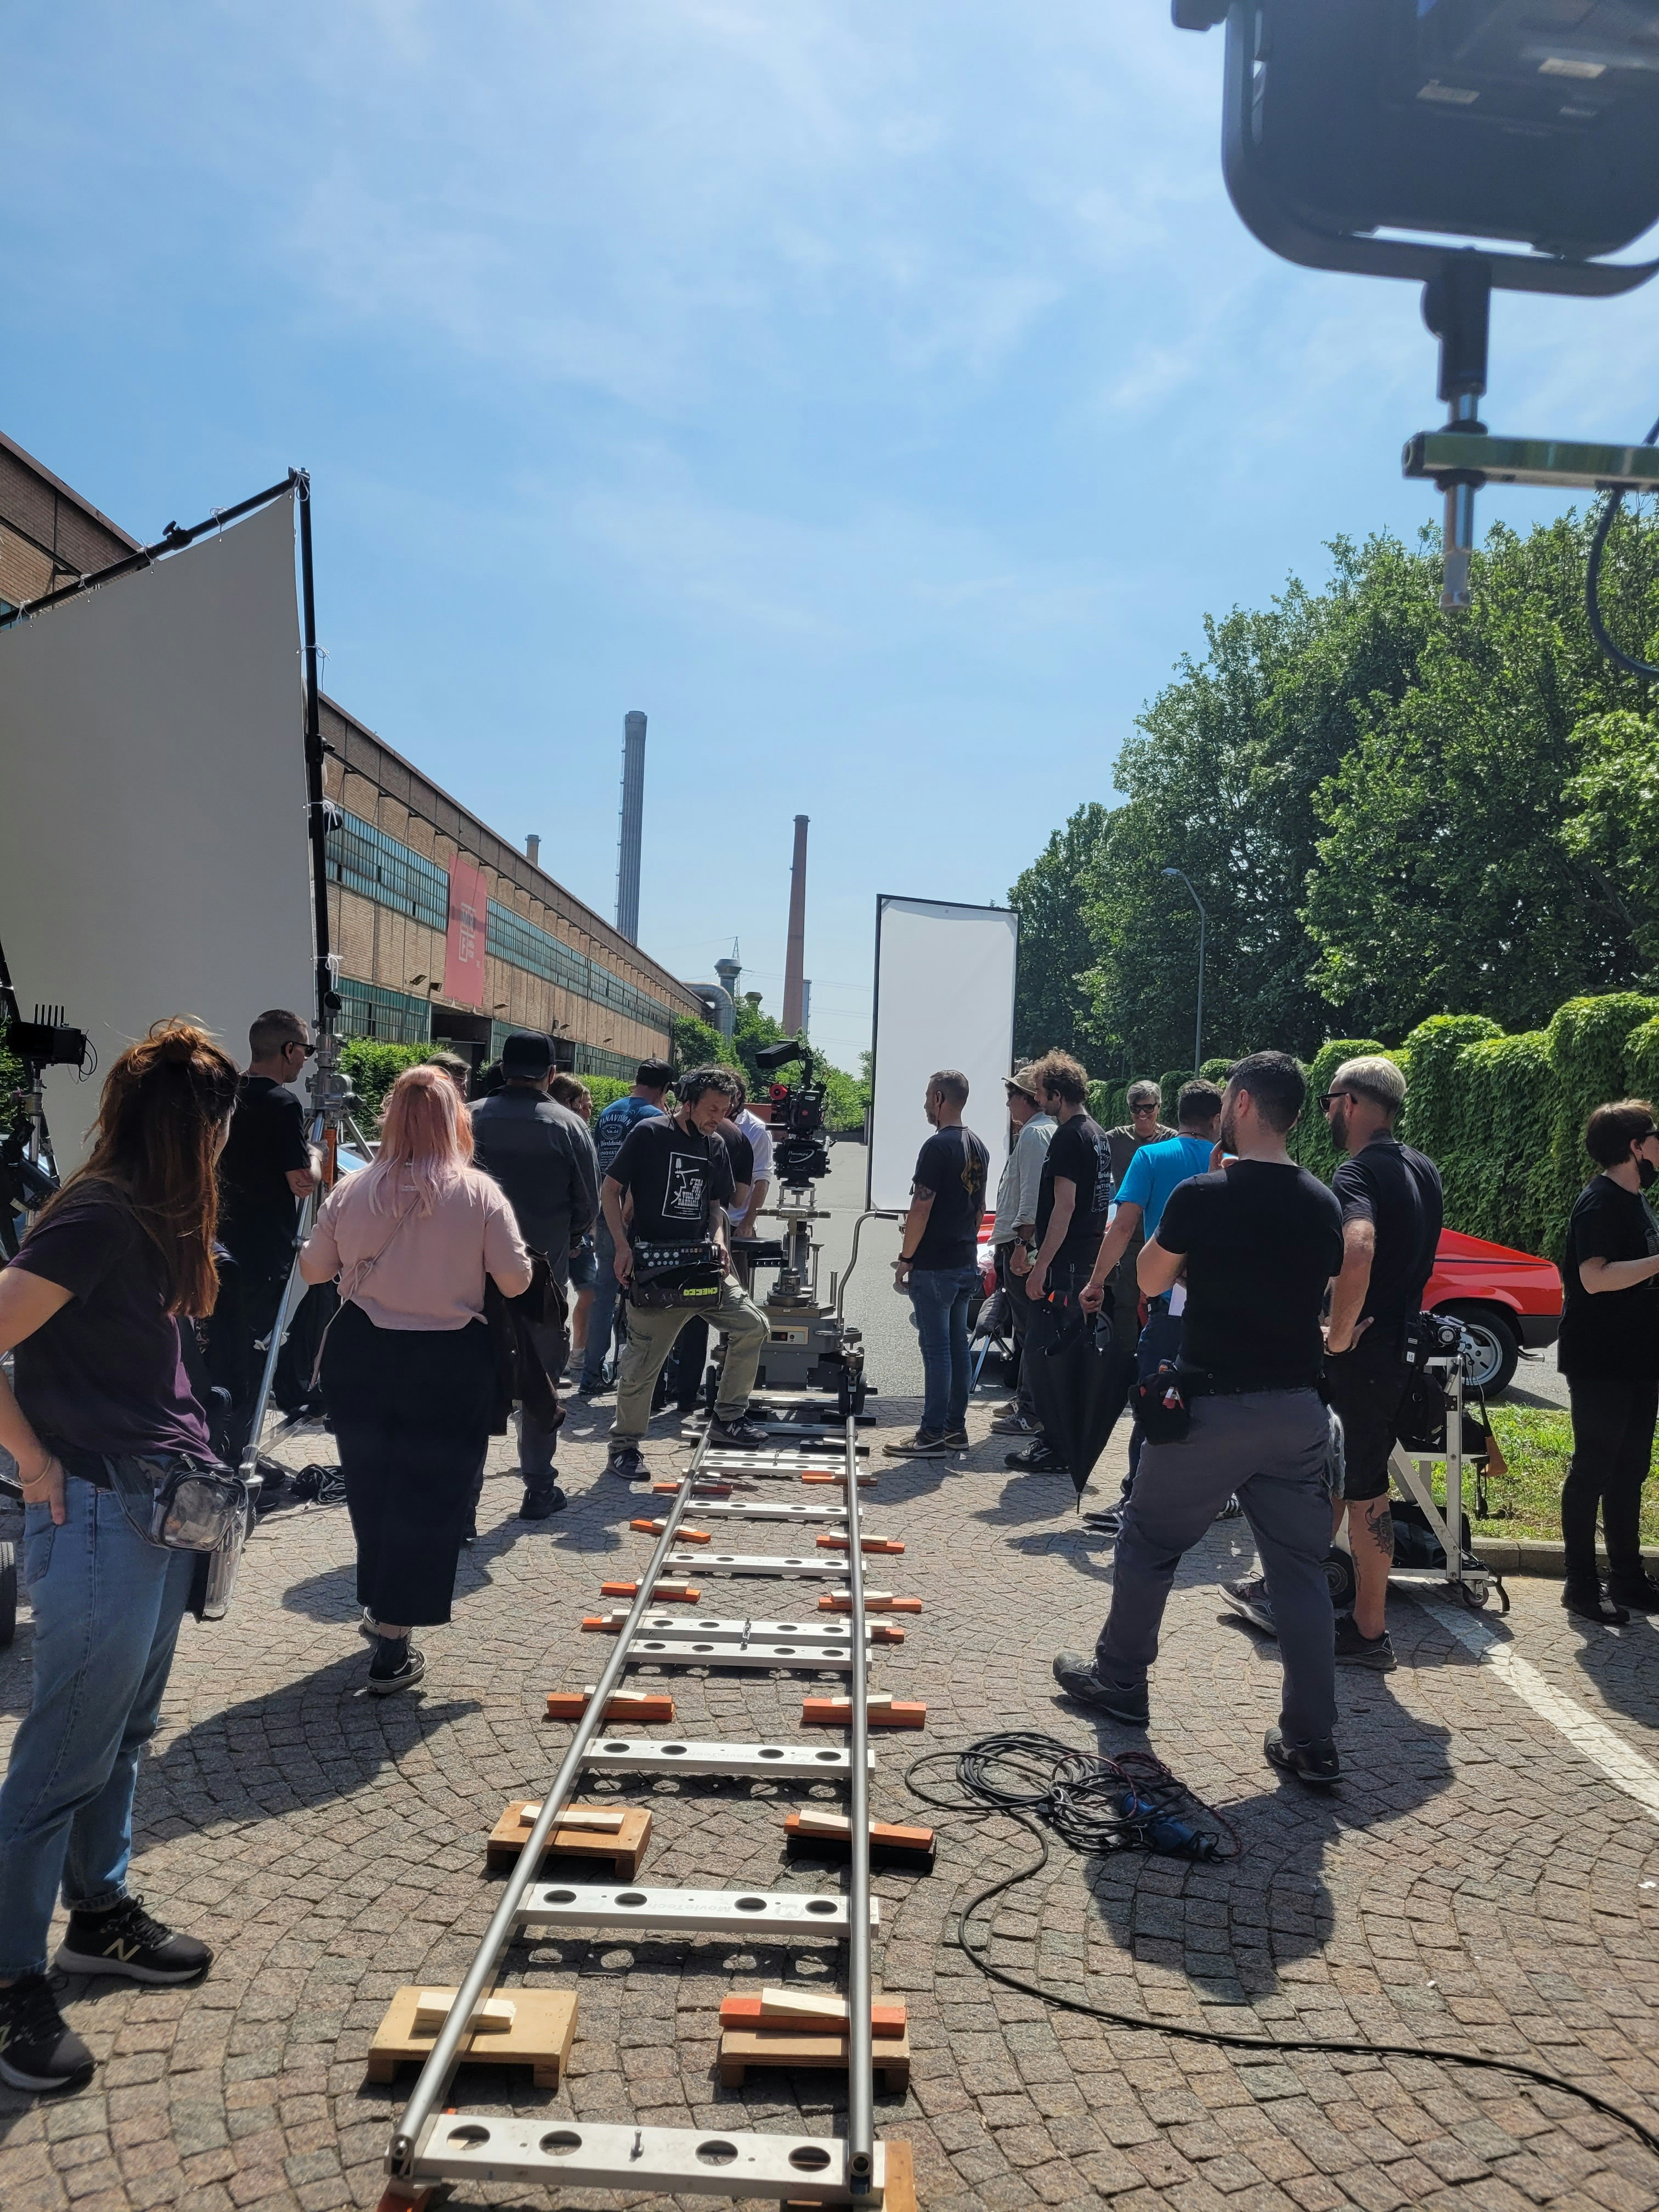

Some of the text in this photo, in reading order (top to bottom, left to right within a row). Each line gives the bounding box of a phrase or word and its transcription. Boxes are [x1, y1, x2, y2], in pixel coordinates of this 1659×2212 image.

[599, 1114, 632, 1128] PANAVISION
[648, 1903, 732, 1913] MovieTech
[102, 1938, 141, 1962] N
